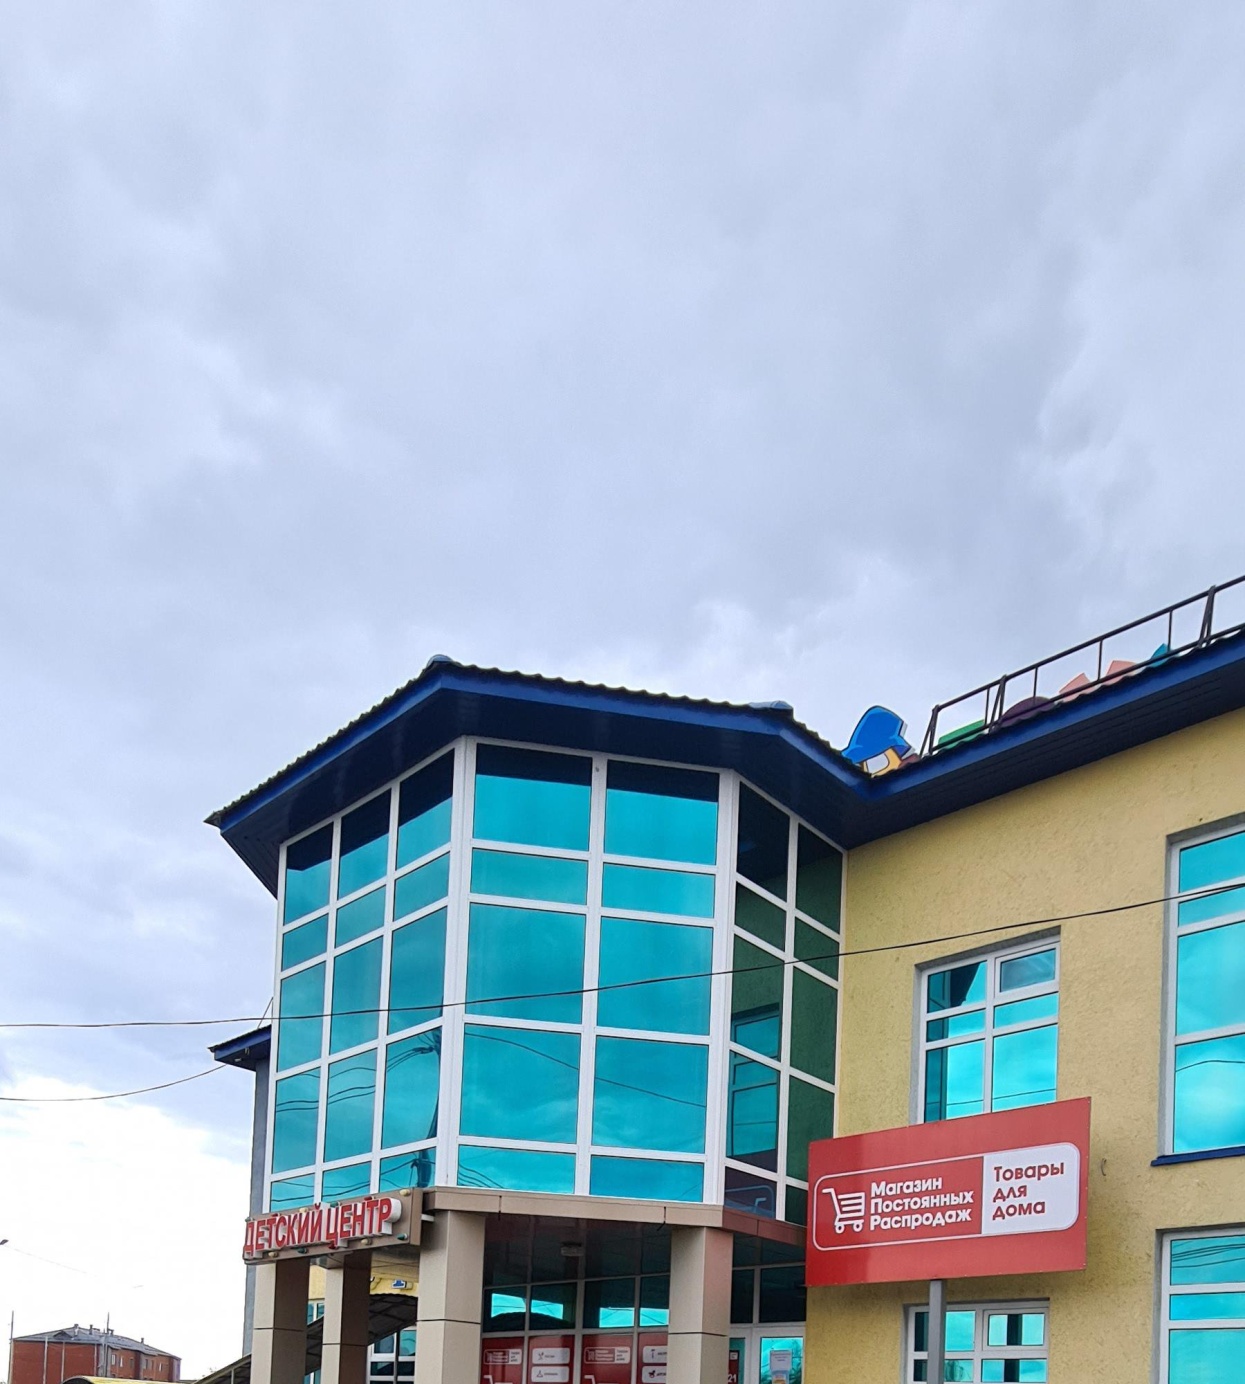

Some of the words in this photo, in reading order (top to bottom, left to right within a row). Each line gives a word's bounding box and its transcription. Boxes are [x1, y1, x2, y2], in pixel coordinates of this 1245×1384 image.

[994, 1160, 1065, 1183] Товары
[871, 1176, 943, 1198] Магазин
[993, 1183, 1028, 1203] для
[870, 1190, 974, 1214] Постоянных
[992, 1200, 1046, 1220] дома
[243, 1202, 323, 1257] ДЕТСКИЙ
[325, 1197, 394, 1247] ЦЕНТР
[870, 1206, 972, 1231] Распродаж
